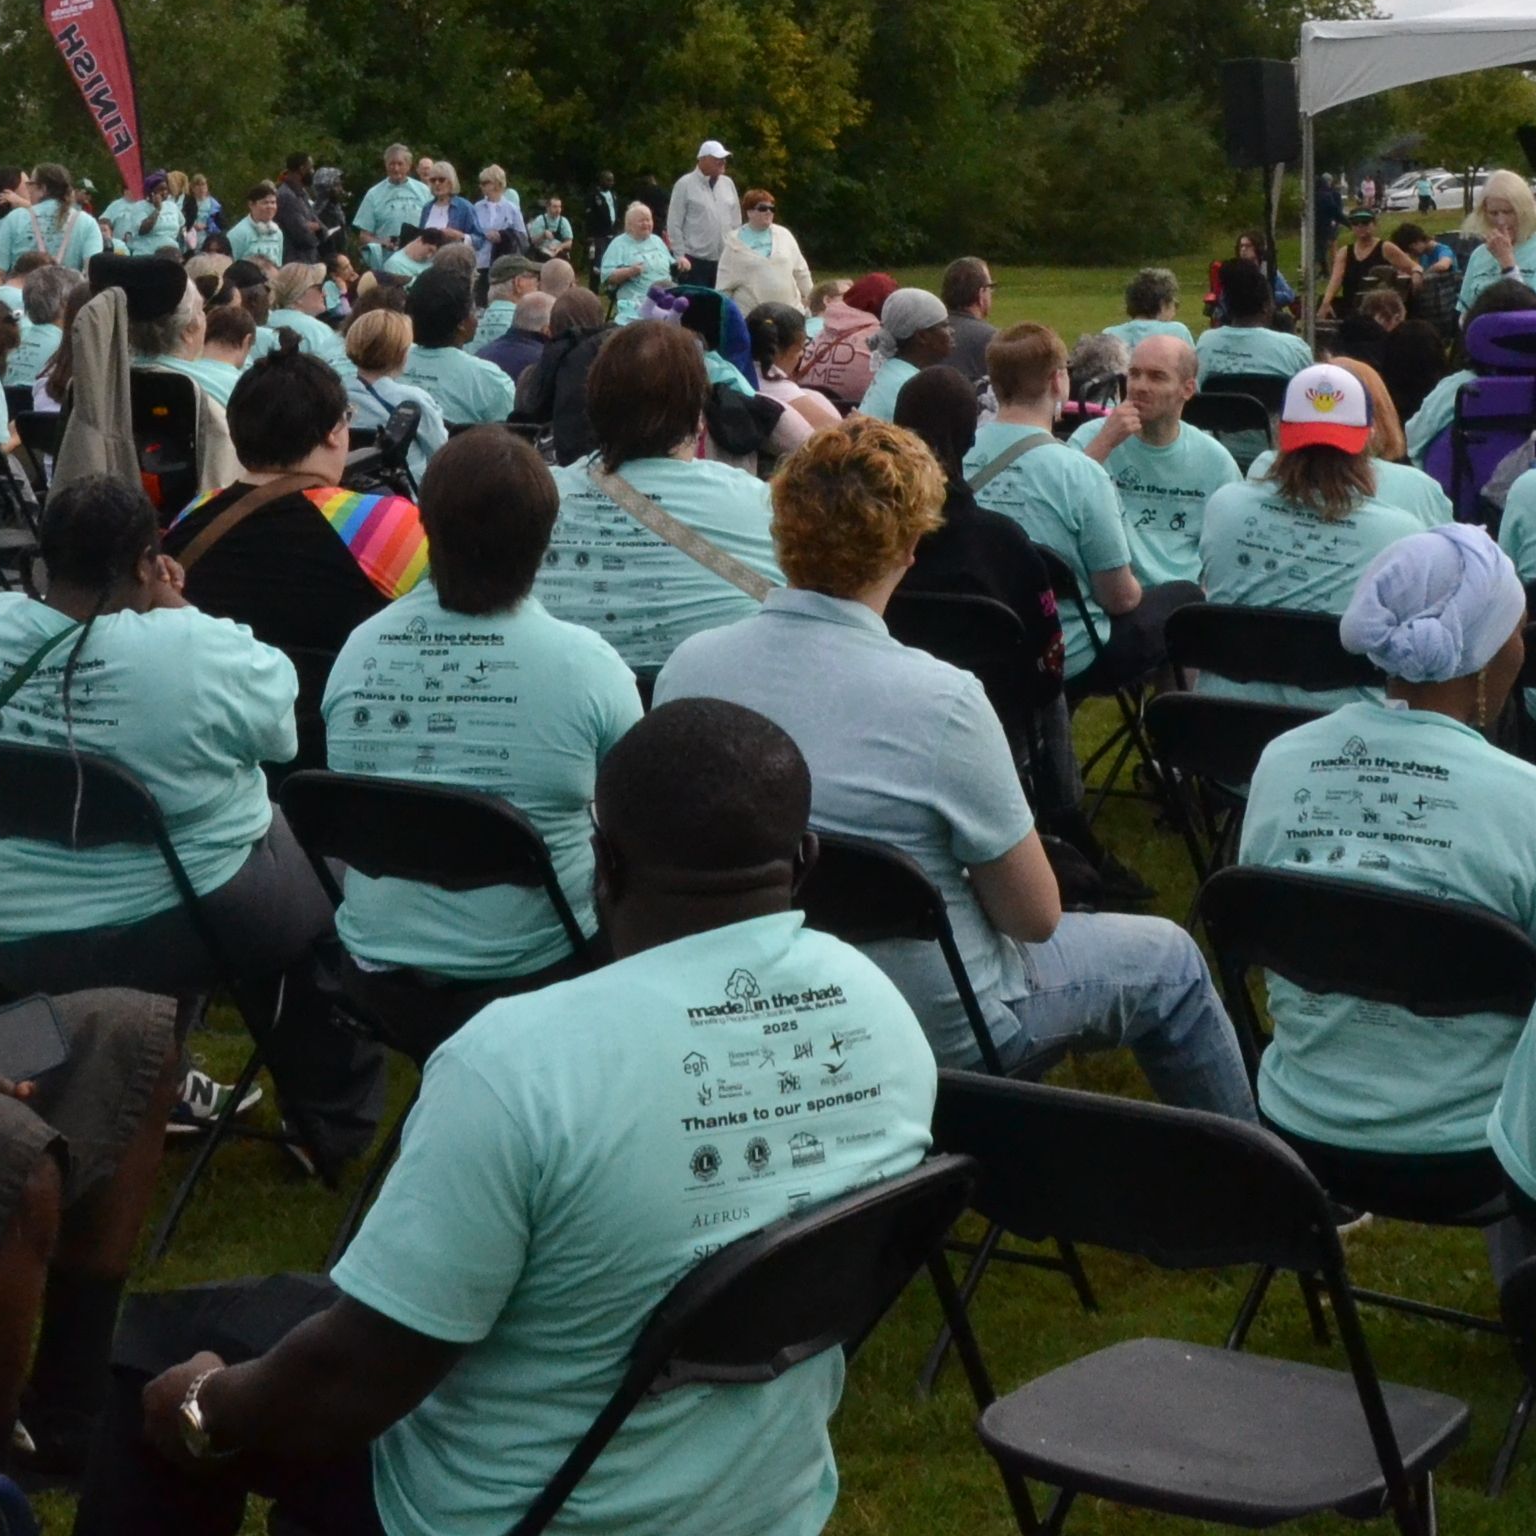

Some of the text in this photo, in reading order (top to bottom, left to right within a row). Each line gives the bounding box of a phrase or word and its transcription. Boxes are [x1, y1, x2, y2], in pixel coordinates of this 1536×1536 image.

[352, 691, 518, 704] Thanks to our sponsors!
[1374, 756, 1401, 768] the
[1402, 760, 1450, 776] shade
[1285, 827, 1452, 849] Thanks to our sponsors!
[687, 983, 844, 1019] made in the shade
[762, 1019, 799, 1035] 2025
[683, 1056, 710, 1077] egh
[189, 1074, 214, 1107] N
[681, 1084, 881, 1132] Thanks to our sponsors!
